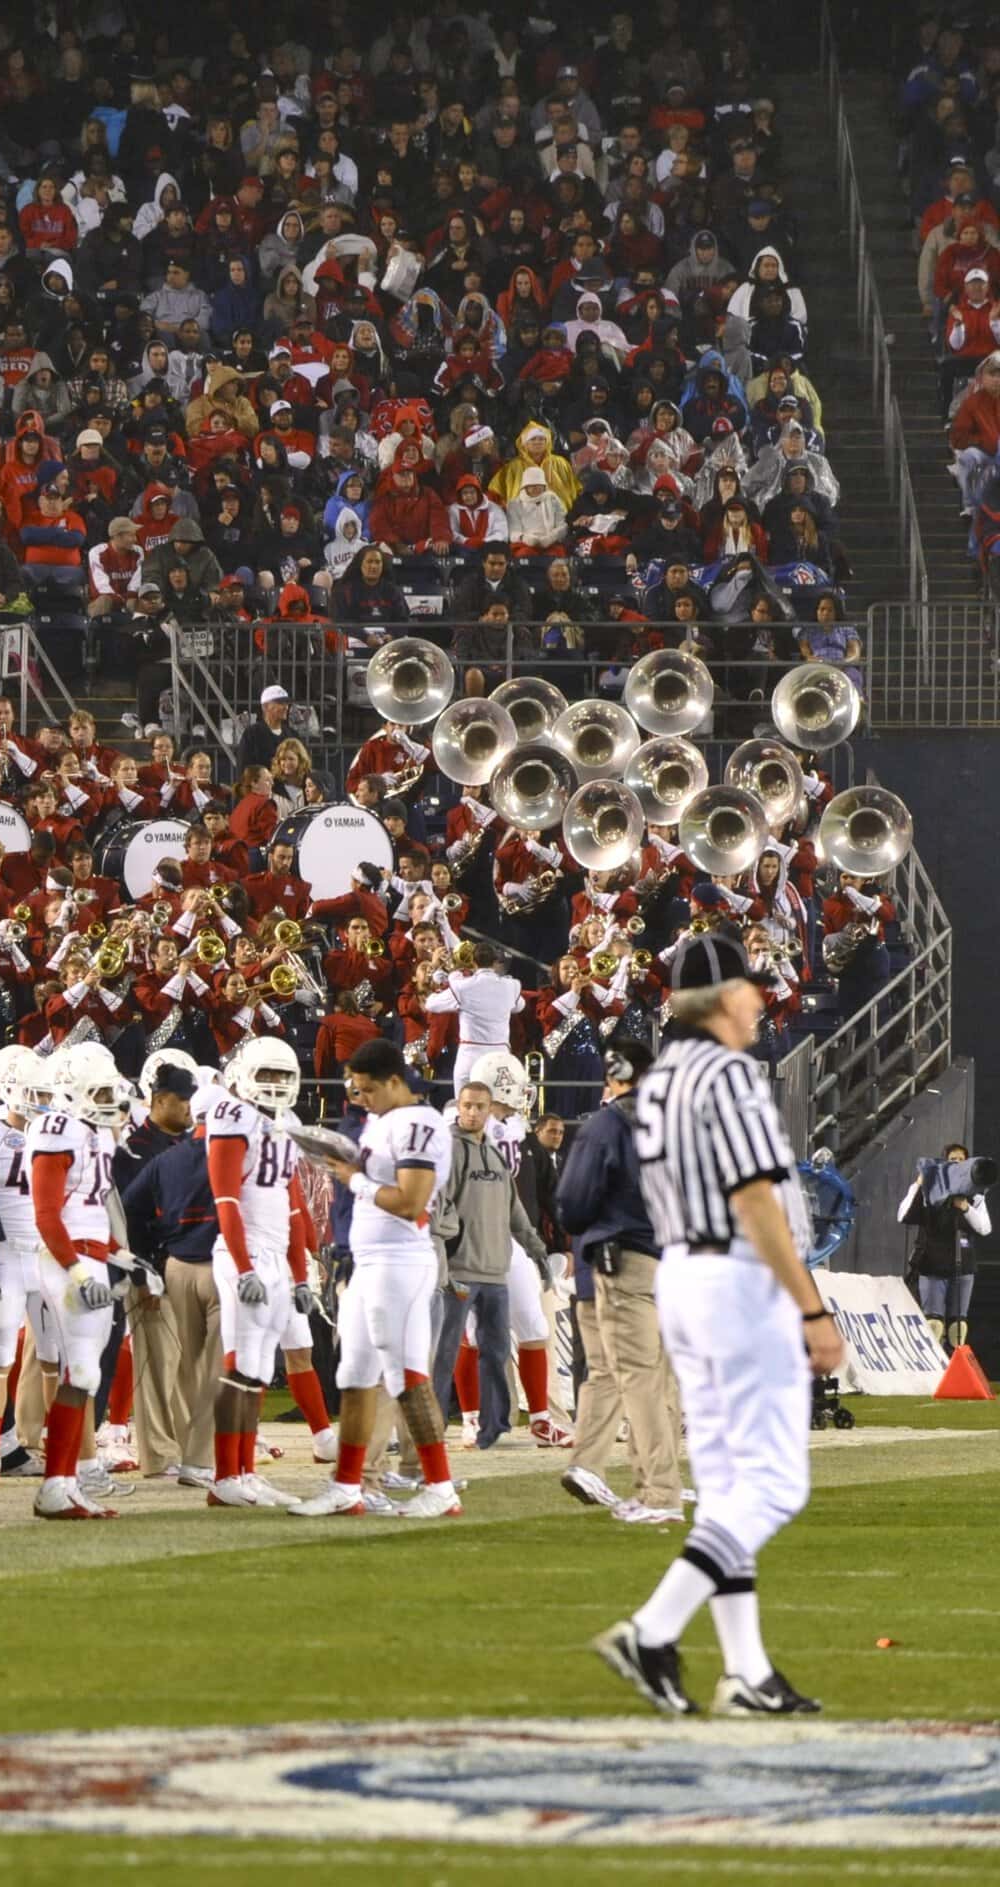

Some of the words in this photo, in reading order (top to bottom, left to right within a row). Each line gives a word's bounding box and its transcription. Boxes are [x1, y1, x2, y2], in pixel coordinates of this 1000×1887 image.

[334, 817, 365, 827] YAMAHA
[493, 1066, 517, 1087] A
[214, 1101, 242, 1122] 84
[40, 1115, 68, 1135] 19
[407, 1123, 434, 1152] 17
